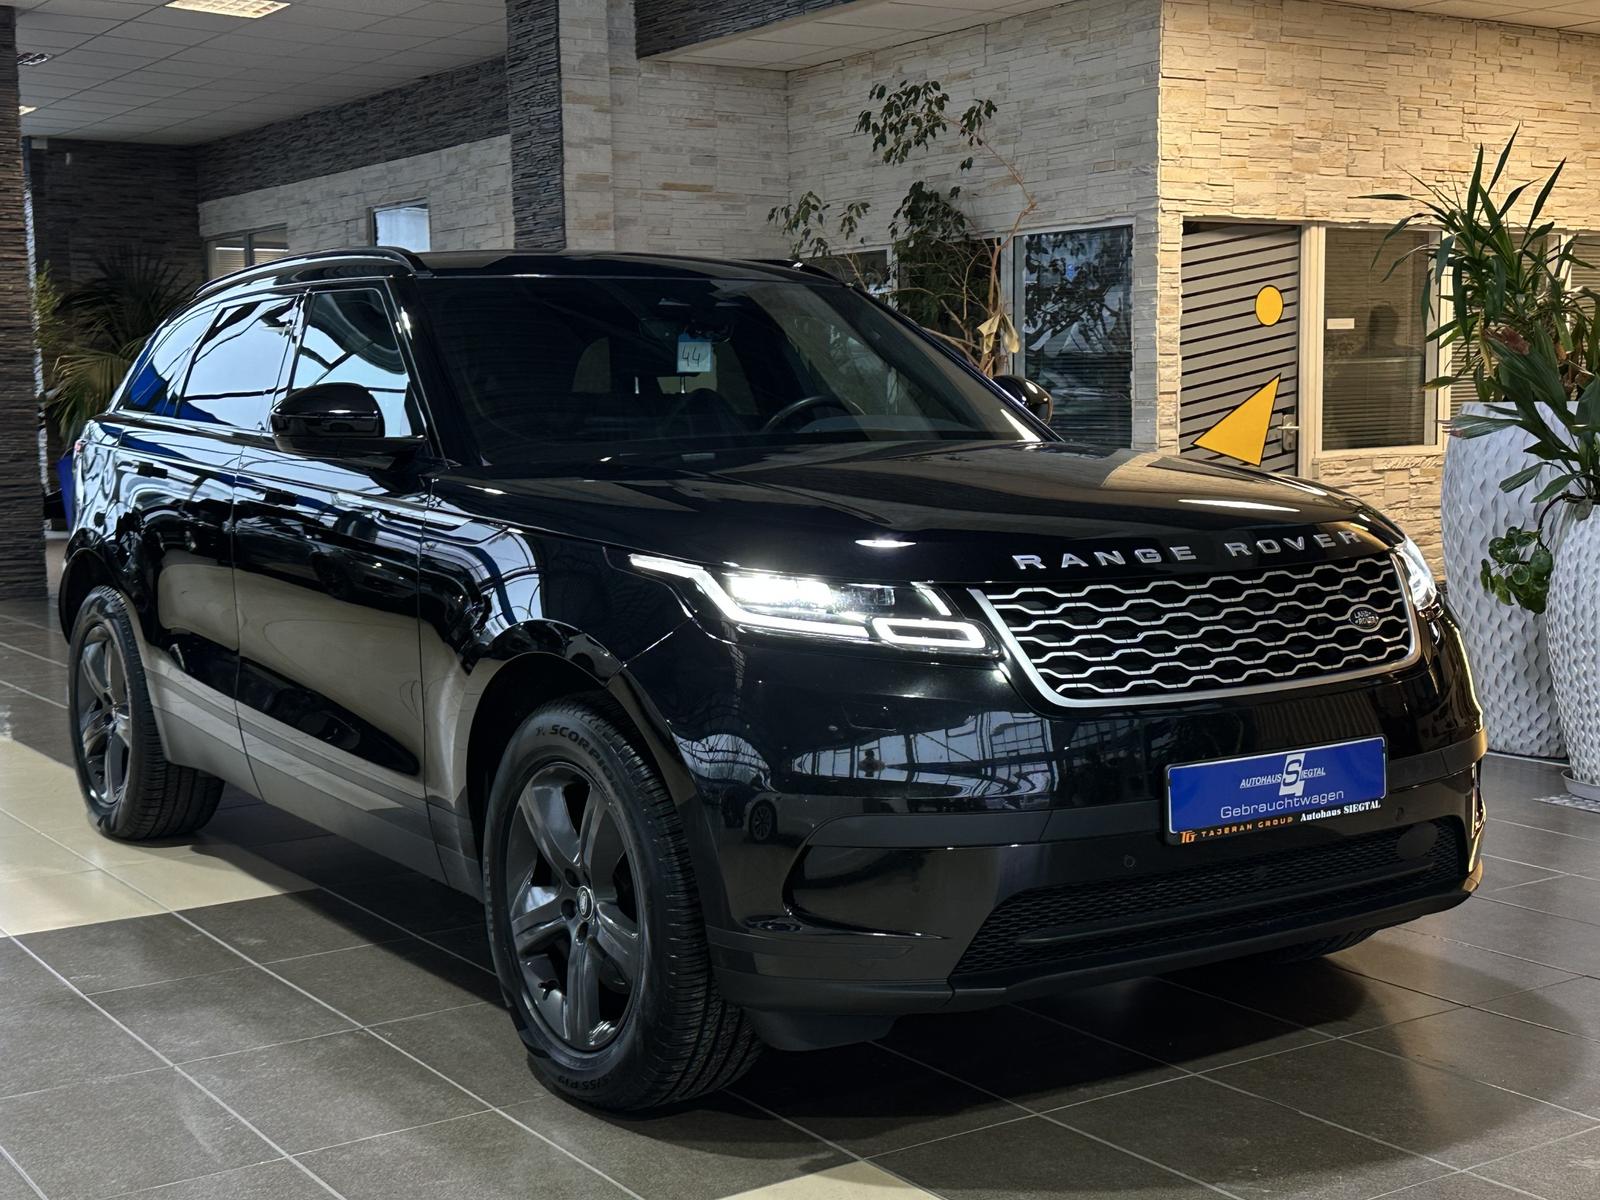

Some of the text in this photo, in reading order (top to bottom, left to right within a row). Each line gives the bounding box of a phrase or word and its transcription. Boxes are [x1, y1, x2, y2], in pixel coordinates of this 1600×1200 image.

[681, 344, 701, 368] 44
[1012, 529, 1362, 570] RANGE ROVER
[1240, 773, 1283, 788] AUTOHAUS
[1220, 790, 1345, 819] Gebrauchtwagen
[1300, 799, 1382, 823] Autohaus SIEGTAL
[1201, 823, 1253, 838] TAJERAN
[1258, 816, 1294, 829] GROUP
